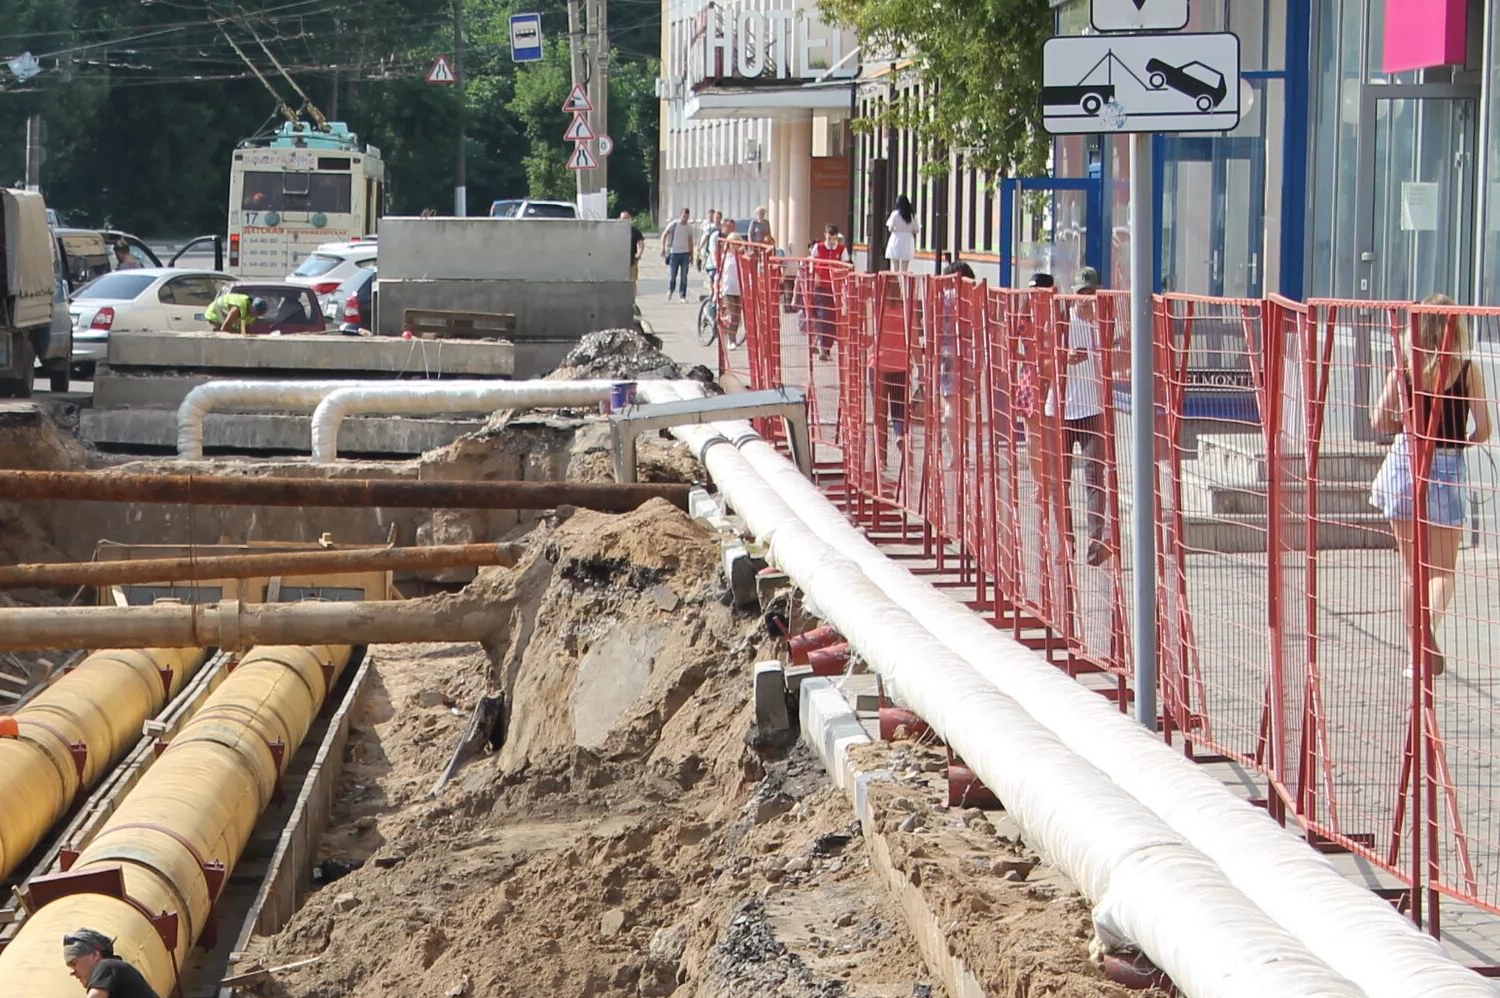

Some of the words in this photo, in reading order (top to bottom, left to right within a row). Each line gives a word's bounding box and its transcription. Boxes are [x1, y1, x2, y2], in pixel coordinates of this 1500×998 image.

[703, 8, 857, 79] HOTEL
[245, 212, 258, 224] 17
[243, 227, 284, 235] ДЕТСКАЯ
